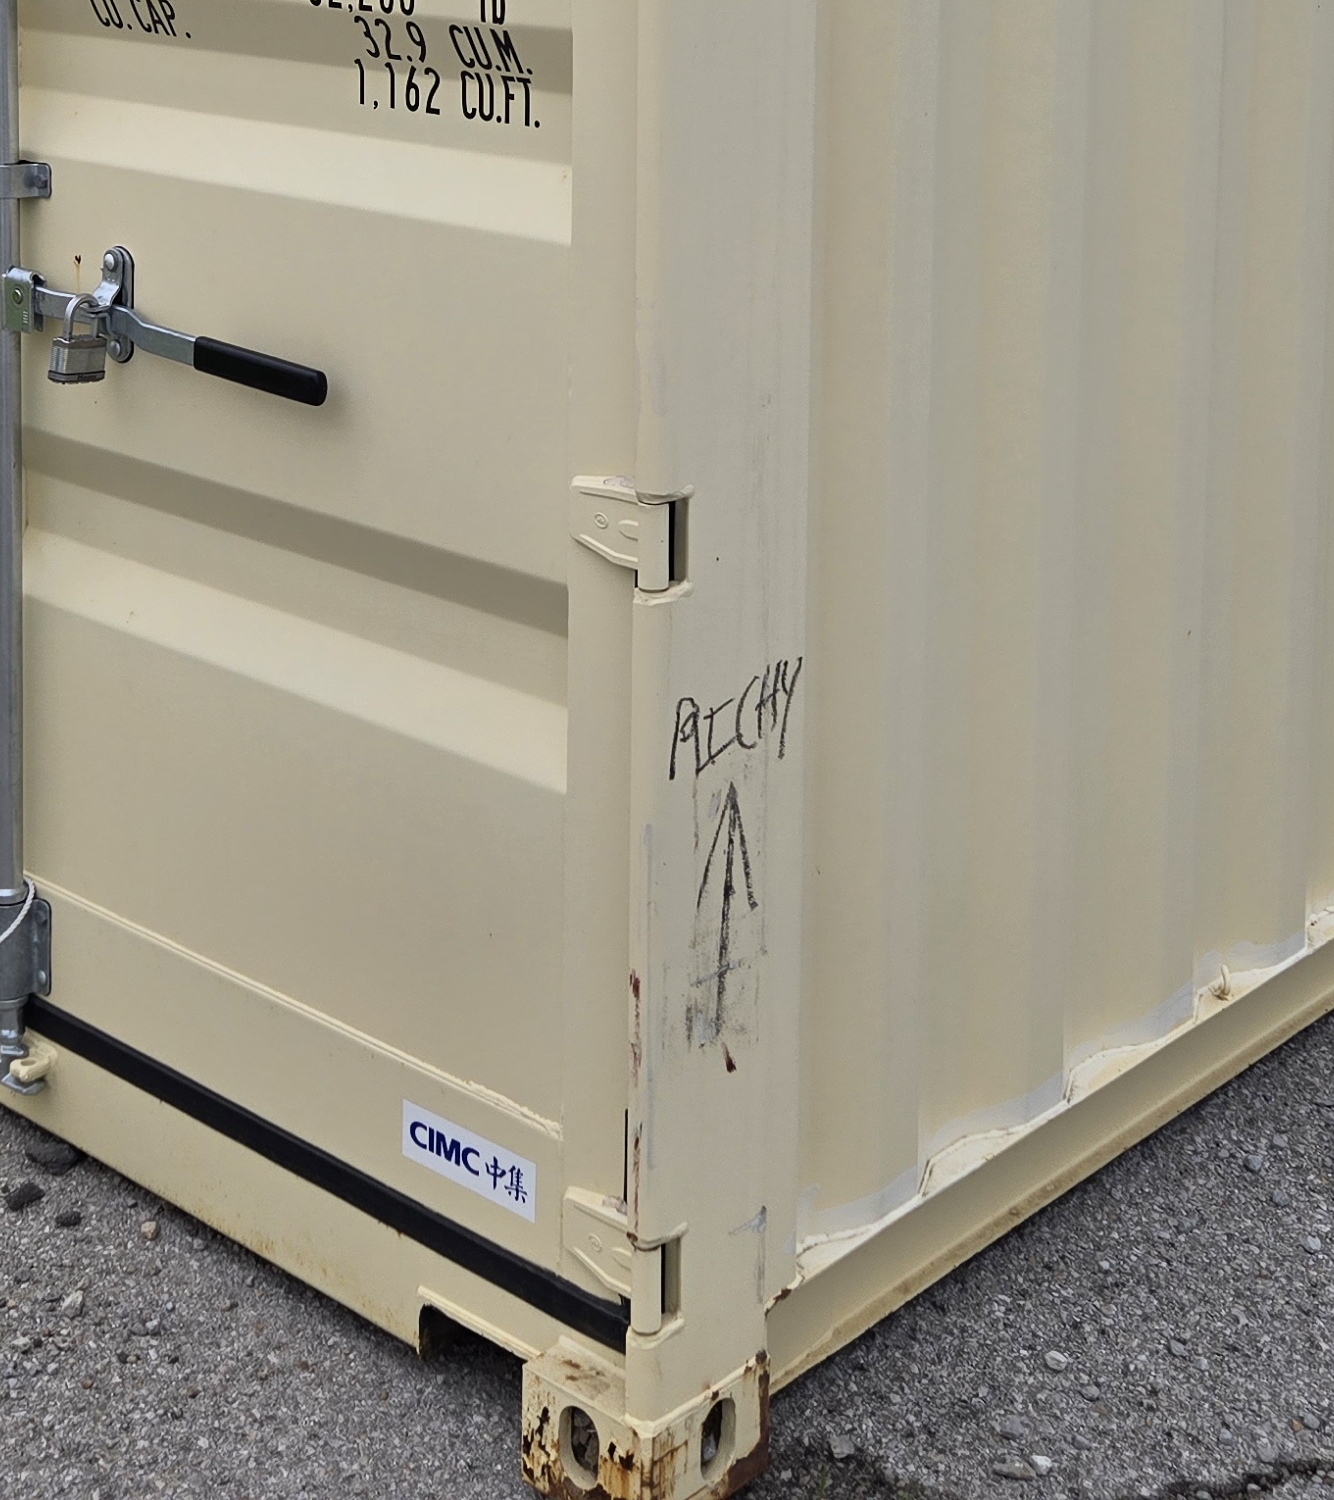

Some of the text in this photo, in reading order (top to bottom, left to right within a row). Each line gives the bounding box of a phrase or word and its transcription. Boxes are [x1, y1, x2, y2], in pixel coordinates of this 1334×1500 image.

[353, 15, 427, 64] 32.9
[448, 24, 534, 76] CU.M.
[353, 58, 541, 129] 1,162 CU.FT.
[409, 1121, 528, 1204] CIMC 中集
